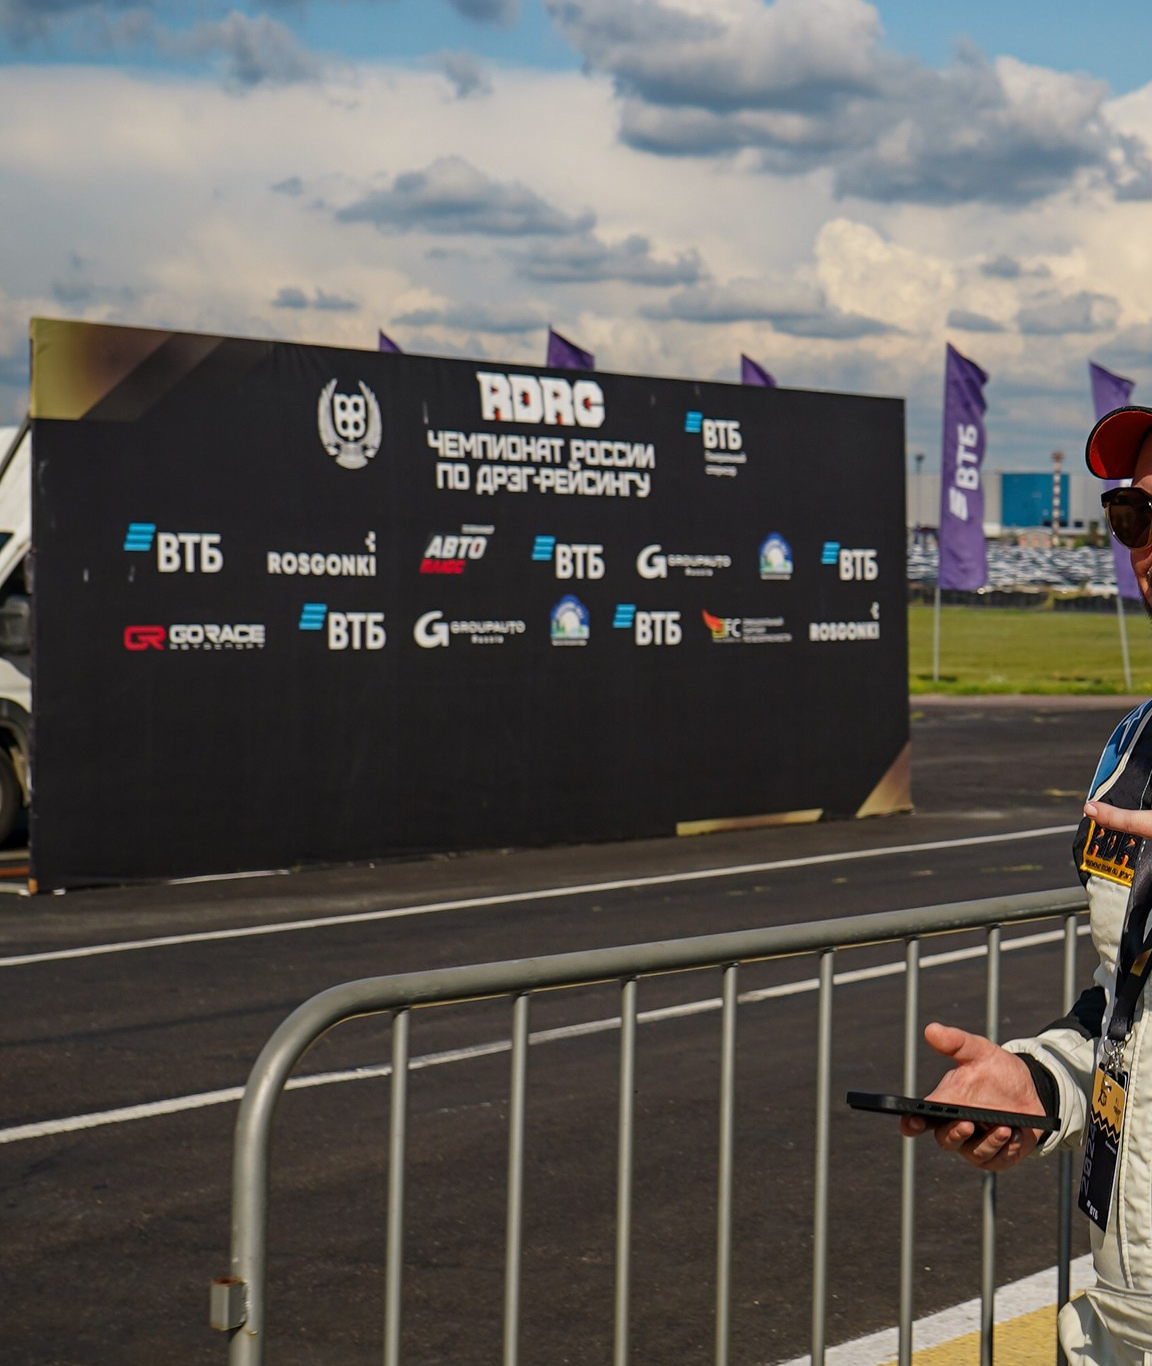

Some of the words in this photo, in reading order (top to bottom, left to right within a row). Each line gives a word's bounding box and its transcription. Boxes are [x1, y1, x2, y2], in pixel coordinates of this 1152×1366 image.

[476, 371, 605, 428] RDRC
[427, 430, 565, 464] ЧЕМПИОНАТ
[570, 438, 656, 469] РОССИИ
[702, 418, 743, 450] ВТБ
[956, 423, 979, 491] ВТБ
[436, 462, 471, 491] ПО
[476, 461, 651, 498] ДРЭГ-РЕЙСИНГУ
[157, 532, 223, 573] ВТБ
[267, 551, 376, 576] ROSGONKI
[424, 536, 487, 559] АВТО
[555, 544, 606, 579] ВТБ
[839, 548, 878, 581] ВТБ
[328, 612, 386, 650] ВТБ
[450, 620, 526, 634] GROUPAUTO
[635, 611, 682, 646] ВТБ
